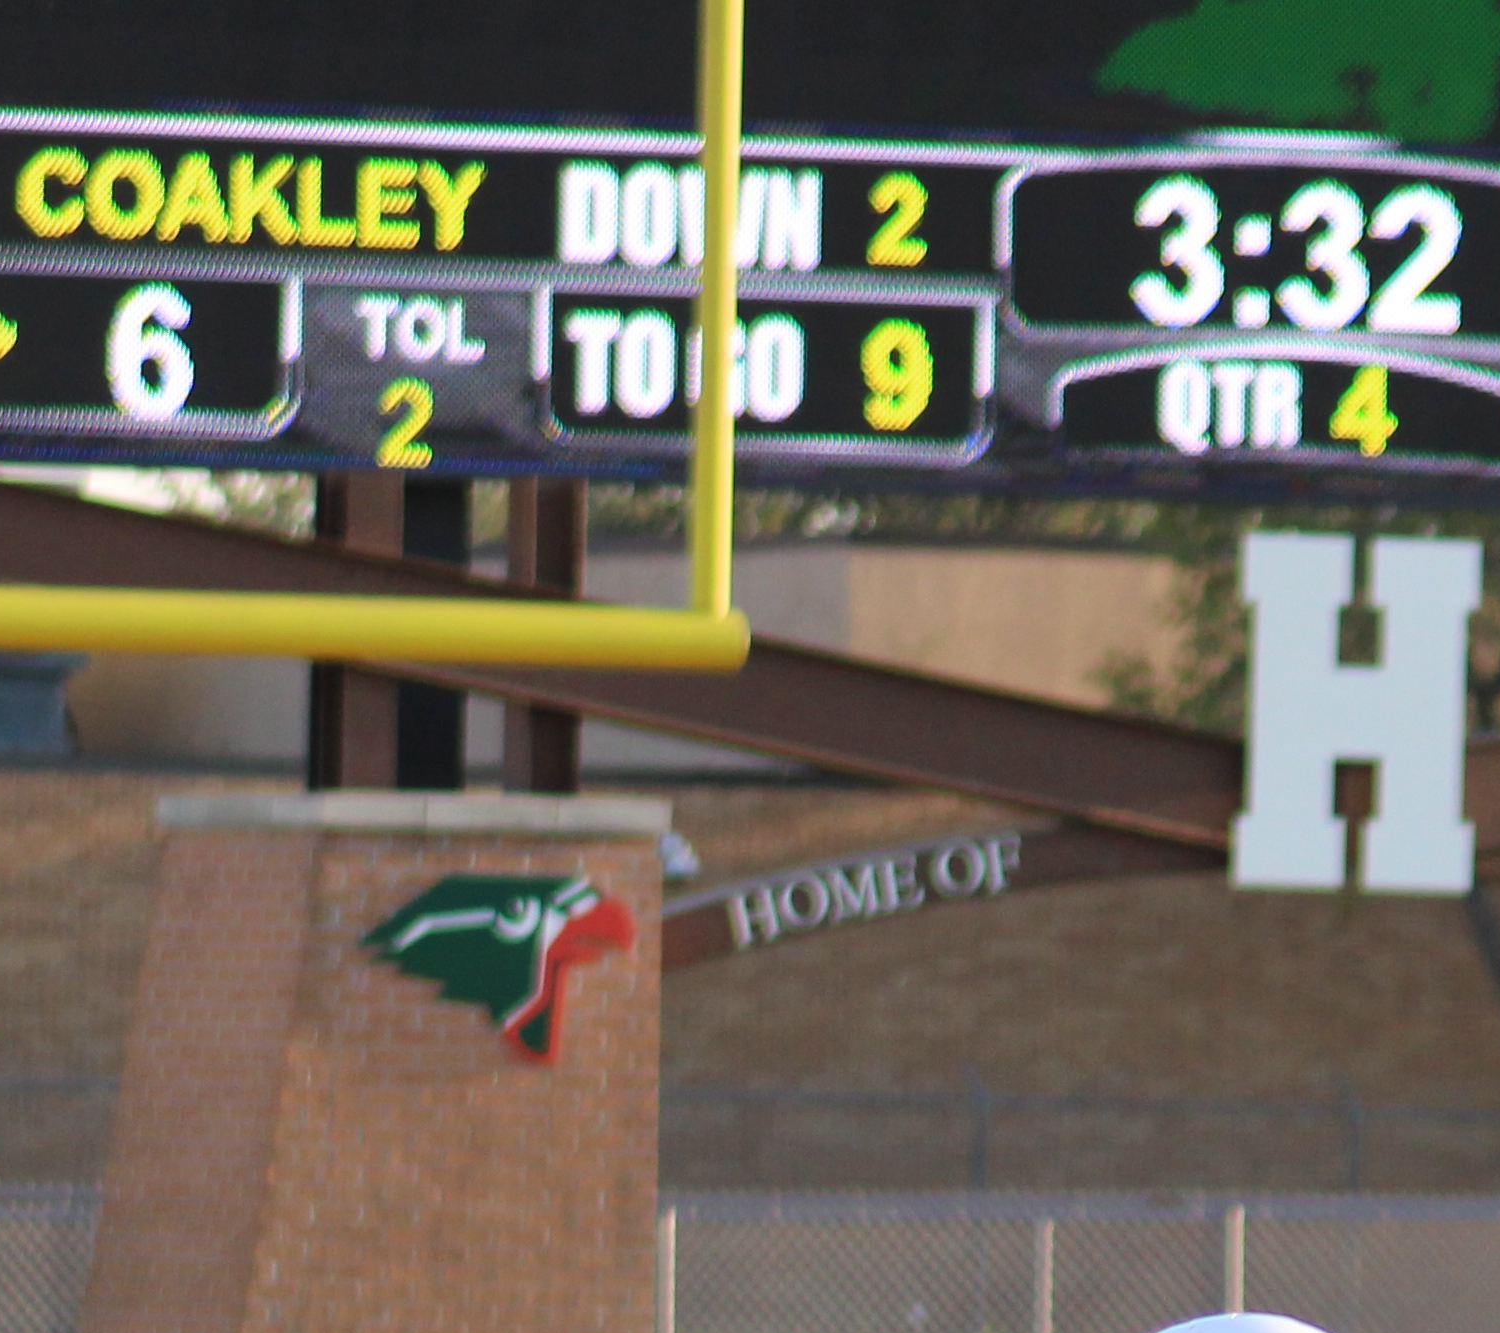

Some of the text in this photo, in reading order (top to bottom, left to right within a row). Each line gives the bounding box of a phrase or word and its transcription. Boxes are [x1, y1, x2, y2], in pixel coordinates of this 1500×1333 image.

[14, 146, 487, 252] COAKLEY
[867, 173, 928, 267] 2
[1129, 173, 1462, 336] 3:32
[107, 282, 194, 420] 6
[354, 295, 485, 363] TOL
[563, 308, 677, 418] TO
[861, 318, 934, 431] 9
[378, 377, 435, 469] 2
[1157, 358, 1397, 457] QTR 4
[1229, 531, 1484, 894] H
[729, 833, 1023, 951] HOME OF
